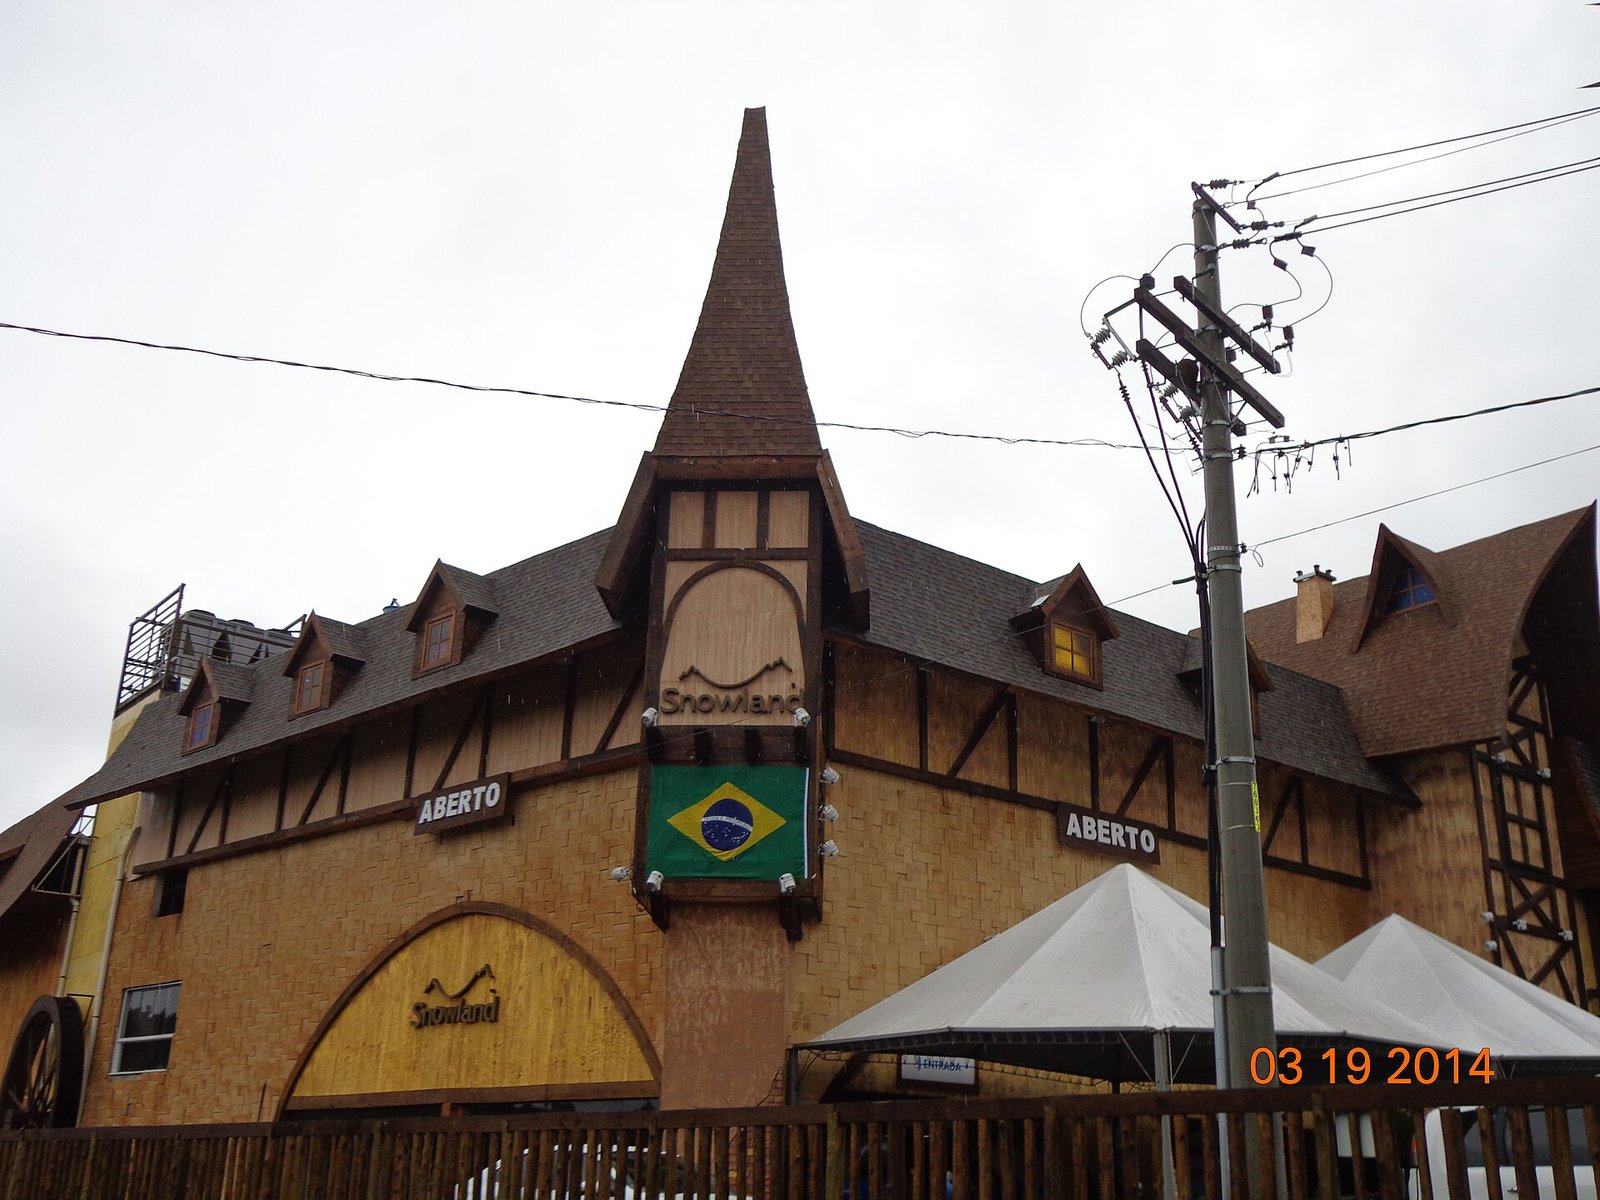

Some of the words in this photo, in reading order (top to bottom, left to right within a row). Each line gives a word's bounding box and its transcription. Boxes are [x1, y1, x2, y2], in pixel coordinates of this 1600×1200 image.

[418, 782, 500, 824] ABERTO
[1066, 812, 1155, 854] ABERTO
[410, 996, 500, 1028] Snowland
